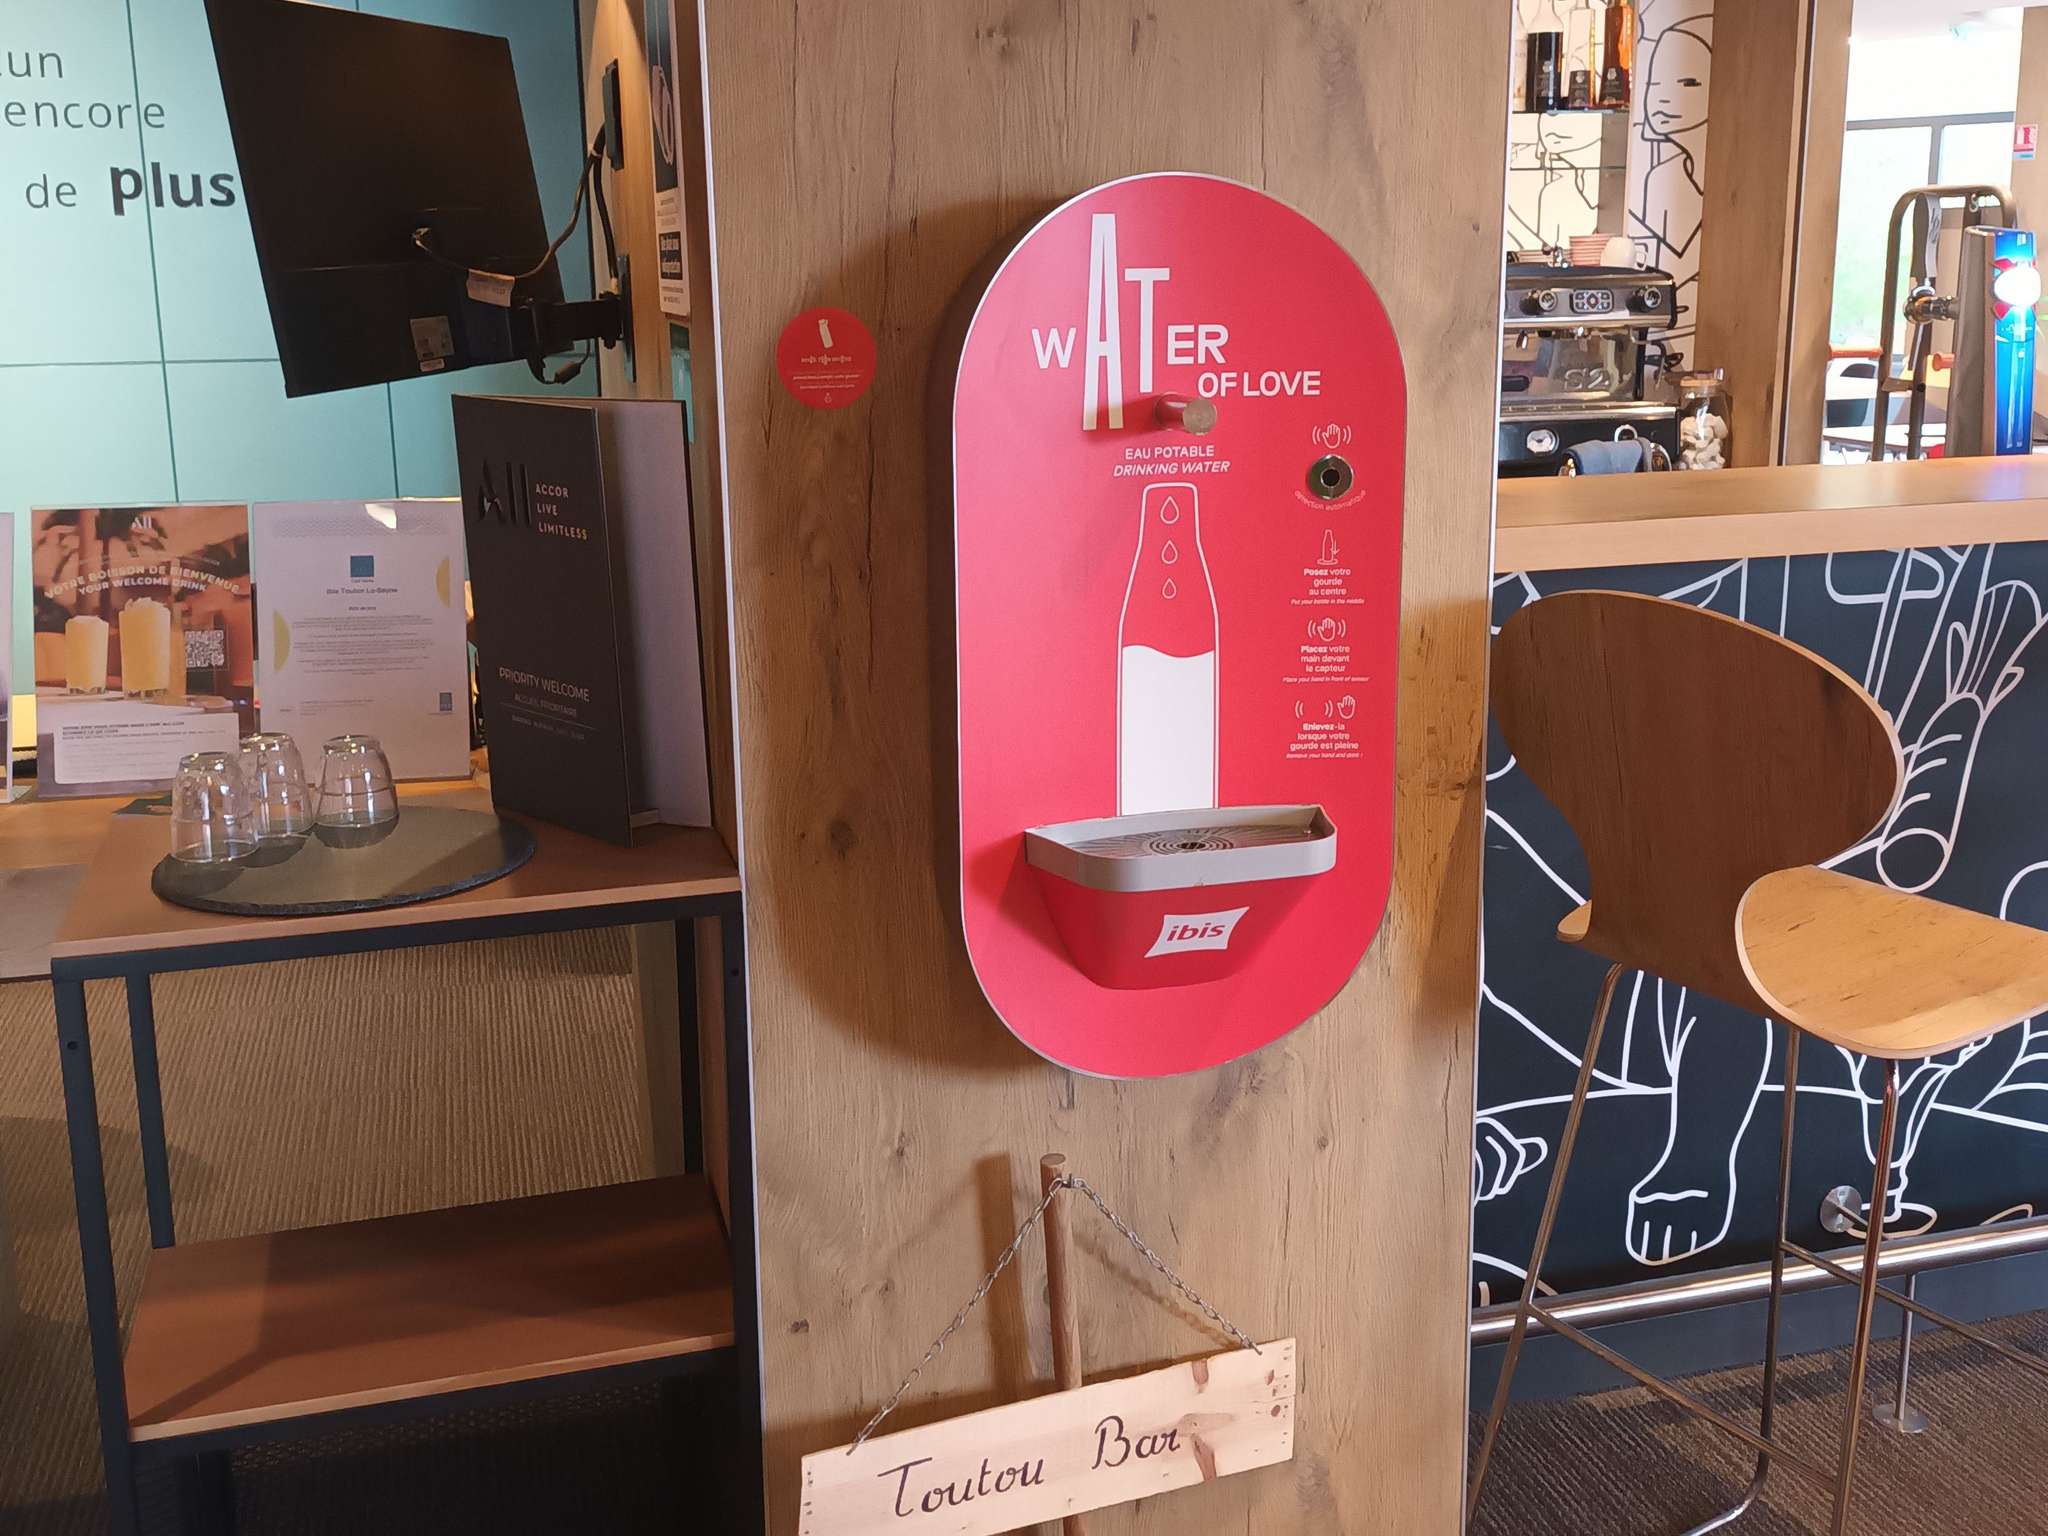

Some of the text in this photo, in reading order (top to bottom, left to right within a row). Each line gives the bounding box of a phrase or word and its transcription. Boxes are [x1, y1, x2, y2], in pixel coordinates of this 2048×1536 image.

[0, 51, 63, 78] un
[4, 101, 165, 128] encore
[26, 162, 236, 216] de plus
[1032, 213, 1229, 430] WATER
[1198, 370, 1321, 398] OF LOVE
[1125, 445, 1215, 460] EAU POTABLE
[1113, 460, 1230, 477] DRINKING WATER
[535, 483, 569, 498] ACCOR
[537, 503, 558, 516] LIVE
[538, 522, 588, 541] LIMITLESS
[1303, 568, 1351, 576] Posez votre
[44, 565, 242, 599] VOTRE BOISSON DE BIENVENUE
[79, 577, 207, 596] YOUR WELCOME DRINK
[1313, 577, 1343, 587] gourde
[1308, 588, 1347, 596] au centre
[1300, 645, 1351, 653] Placez votre
[1314, 665, 1346, 674] capteur
[499, 667, 590, 702] PRIORITY WELCOME
[1302, 722, 1345, 731] Enlevez-la
[1297, 732, 1350, 741] lorsque votre
[1289, 741, 1359, 751] gourde est pleine
[1166, 922, 1225, 942] ibis
[878, 1414, 1182, 1517] Toutou Bar
